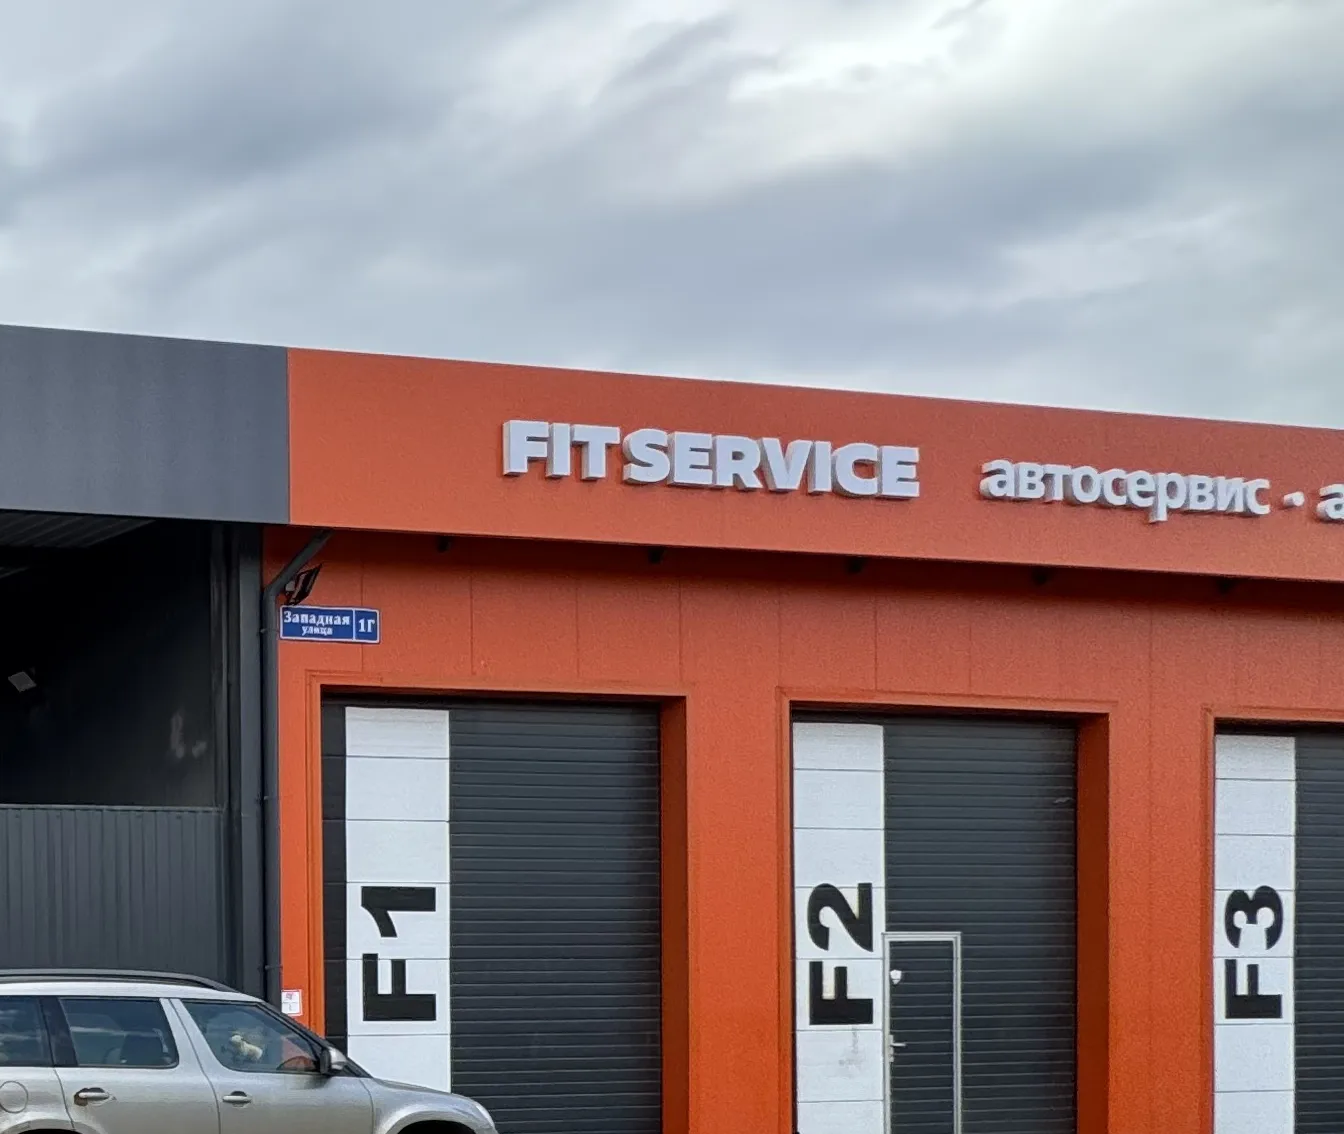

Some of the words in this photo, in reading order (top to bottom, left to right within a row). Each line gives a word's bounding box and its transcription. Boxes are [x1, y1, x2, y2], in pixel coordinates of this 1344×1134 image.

[980, 459, 1270, 523] автосервис
[283, 611, 350, 626] Западная
[358, 618, 375, 633] 1Г
[301, 625, 333, 636] улица
[361, 886, 436, 1021] F1
[807, 883, 873, 1025] F2
[1225, 885, 1284, 1019] F3
